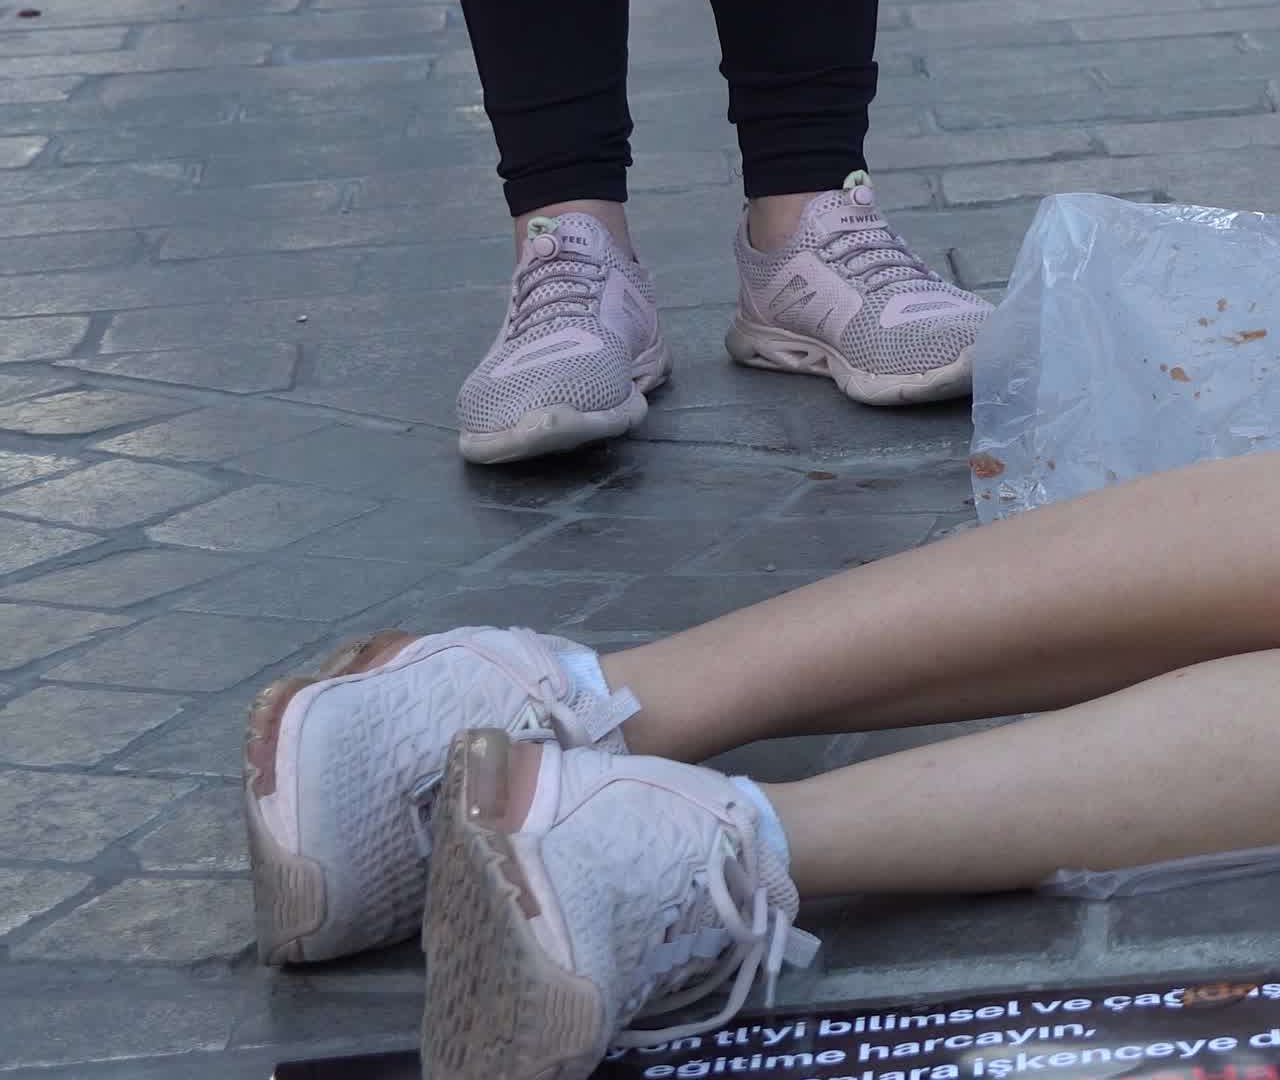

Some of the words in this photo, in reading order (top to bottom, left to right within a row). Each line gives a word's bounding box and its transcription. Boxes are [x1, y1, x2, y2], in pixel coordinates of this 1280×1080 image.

[714, 1022, 806, 1046] tl'yi
[818, 999, 1020, 1037] bilimsel
[1032, 995, 1093, 1015] ve
[644, 1048, 847, 1080] eğitime
[858, 1021, 1097, 1064] harcayın,
[972, 1035, 1238, 1079] işkenceye
